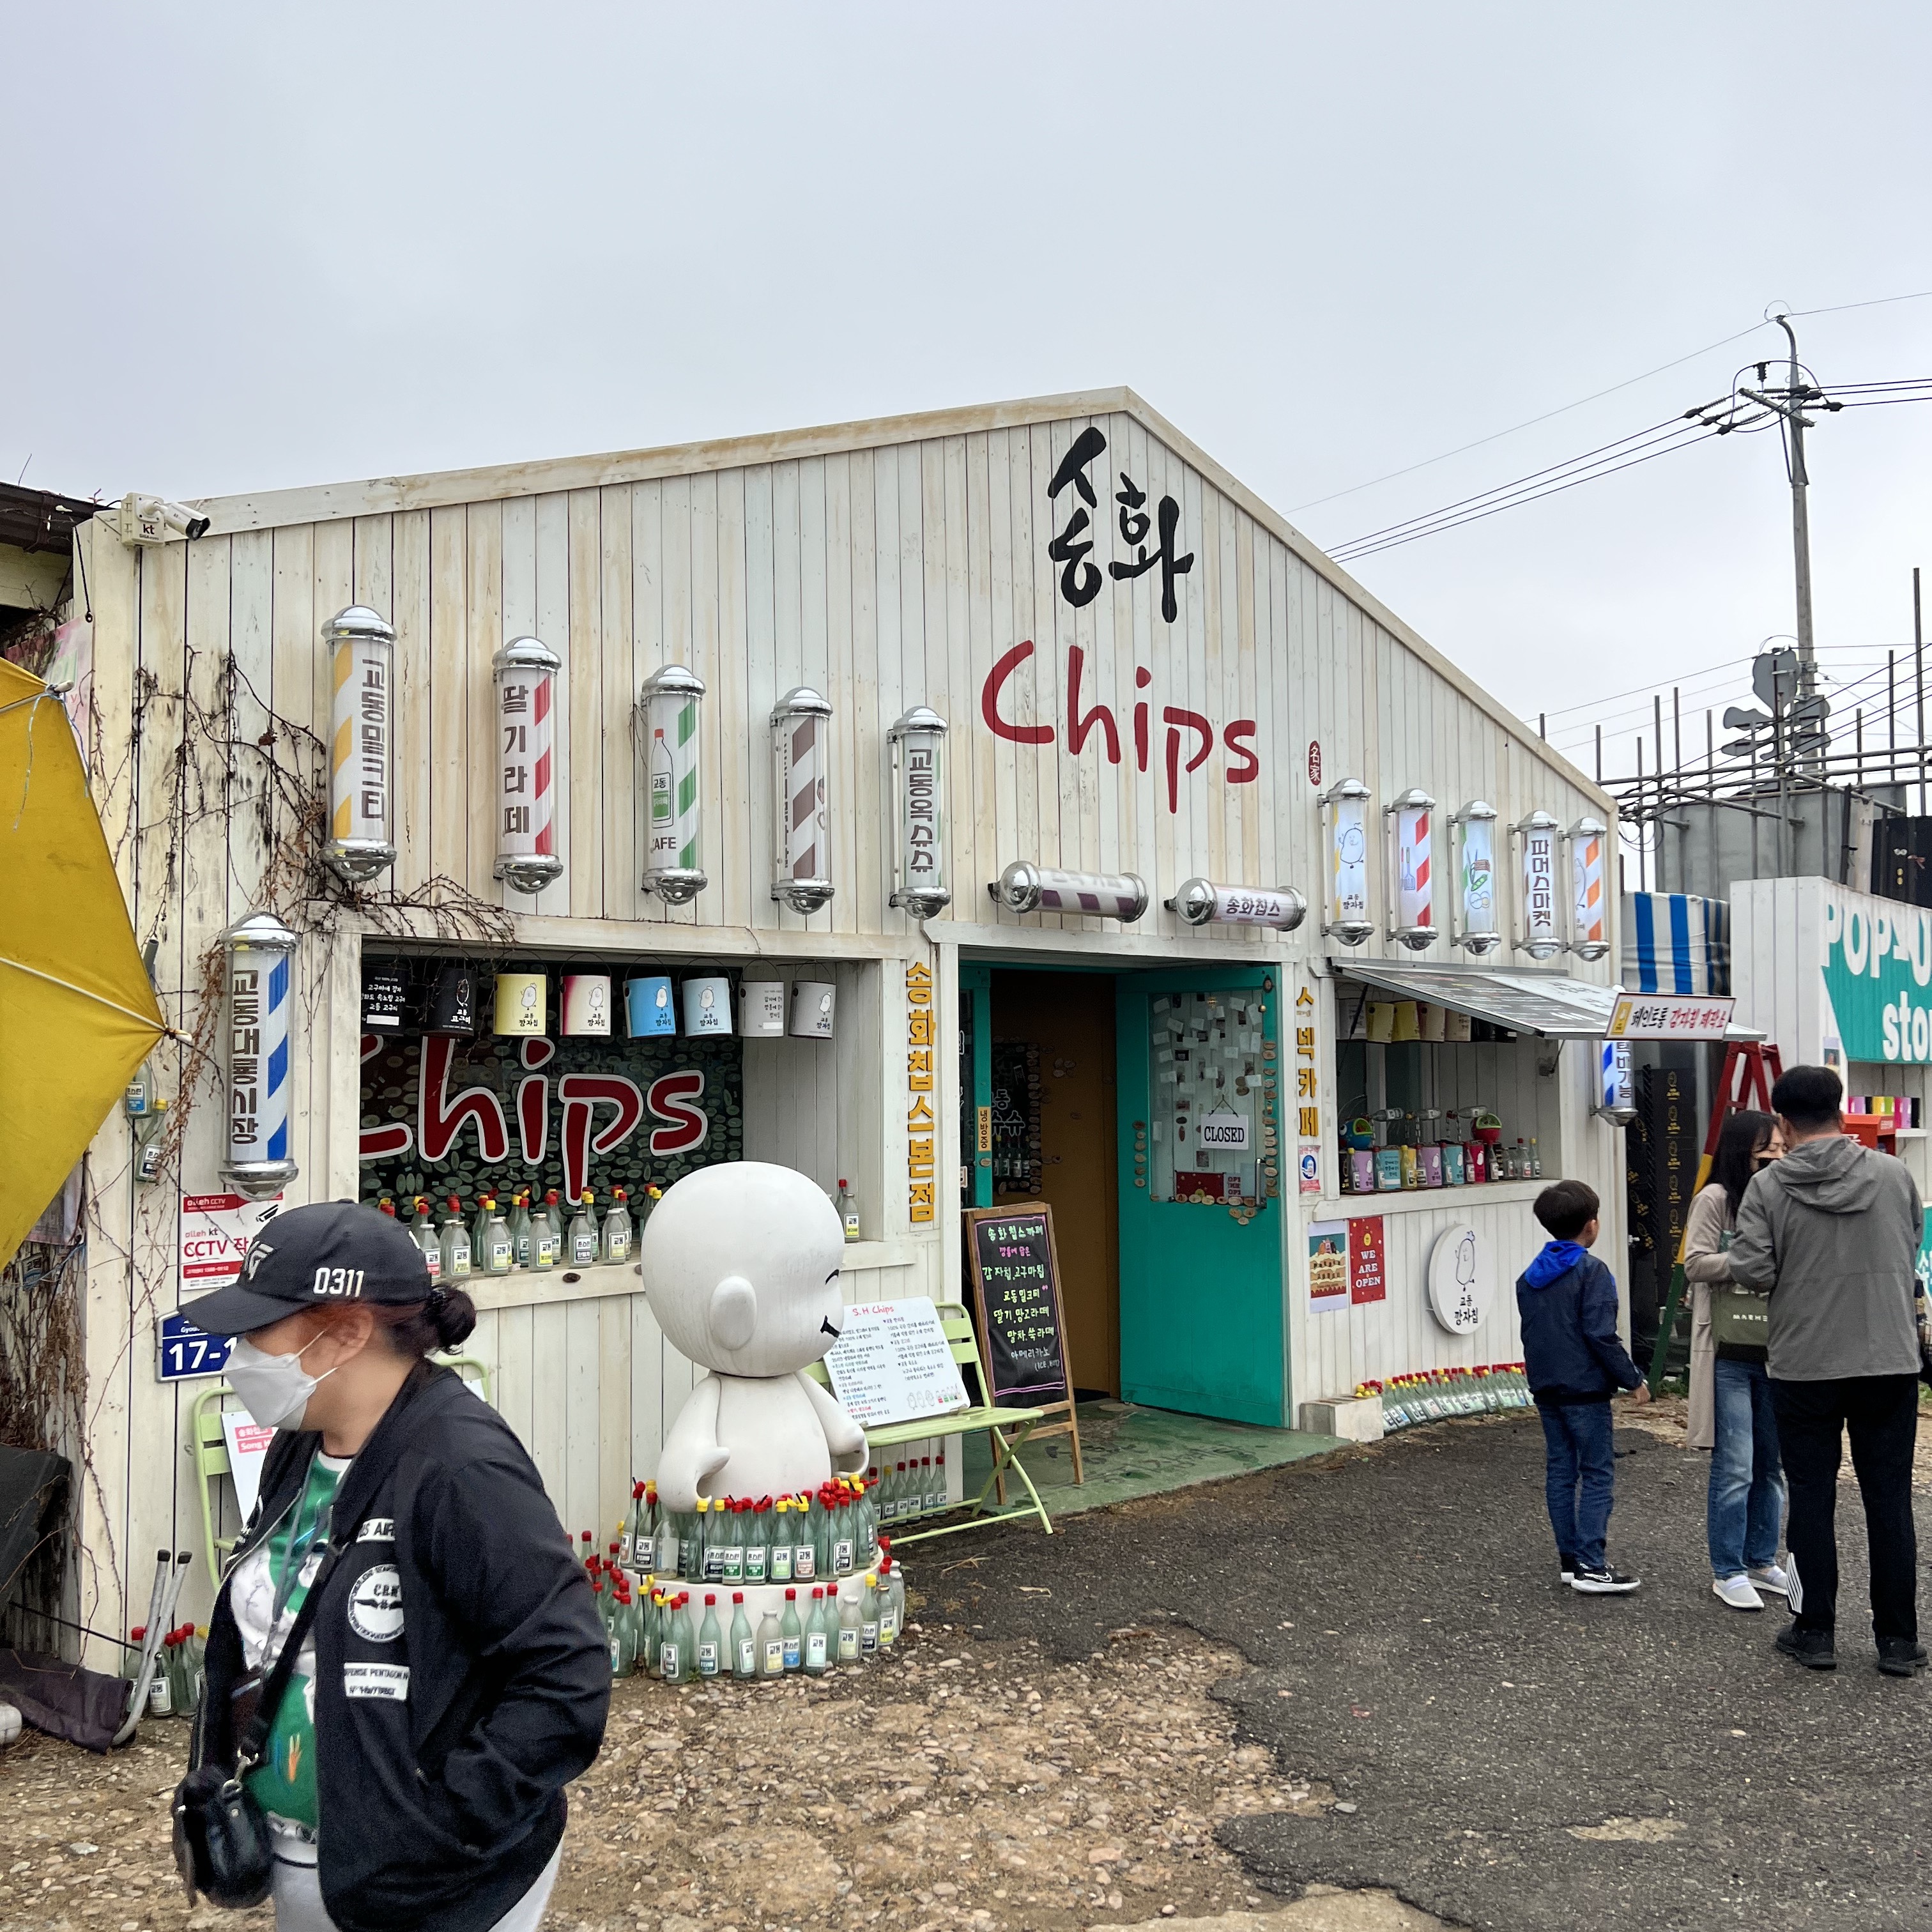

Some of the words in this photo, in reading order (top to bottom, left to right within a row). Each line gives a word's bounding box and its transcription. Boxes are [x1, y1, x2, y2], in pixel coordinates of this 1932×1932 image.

[143, 524, 155, 535] kt
[1047, 427, 1194, 623] 송화
[981, 640, 1259, 814] Chips
[362, 659, 385, 822] 교동밀크티
[503, 685, 529, 834] 딸기라떼
[909, 749, 933, 872] 교동옥슈슈
[652, 837, 676, 850] AFE
[1531, 839, 1551, 927] 파머스마켓
[1630, 1006, 1669, 1028] 페인트통
[1670, 1008, 1700, 1029] 감자칩
[1883, 990, 1932, 1061] sto
[233, 970, 259, 1144] 교동대룡시장
[907, 961, 936, 1223] 송화칩스본점
[1204, 1126, 1245, 1142] CLOSED
[184, 1240, 227, 1257] CCTV
[1360, 1250, 1376, 1260] WE
[1358, 1263, 1378, 1275] ARE
[313, 1268, 364, 1297] 0311
[1355, 1276, 1381, 1288] OPEN
[1460, 1294, 1473, 1307] 교동
[873, 1305, 894, 1315] Chips
[1454, 1307, 1478, 1325] 깡자칩
[1011, 1346, 1050, 1360] 아메리카노
[241, 1441, 263, 1450] Song
